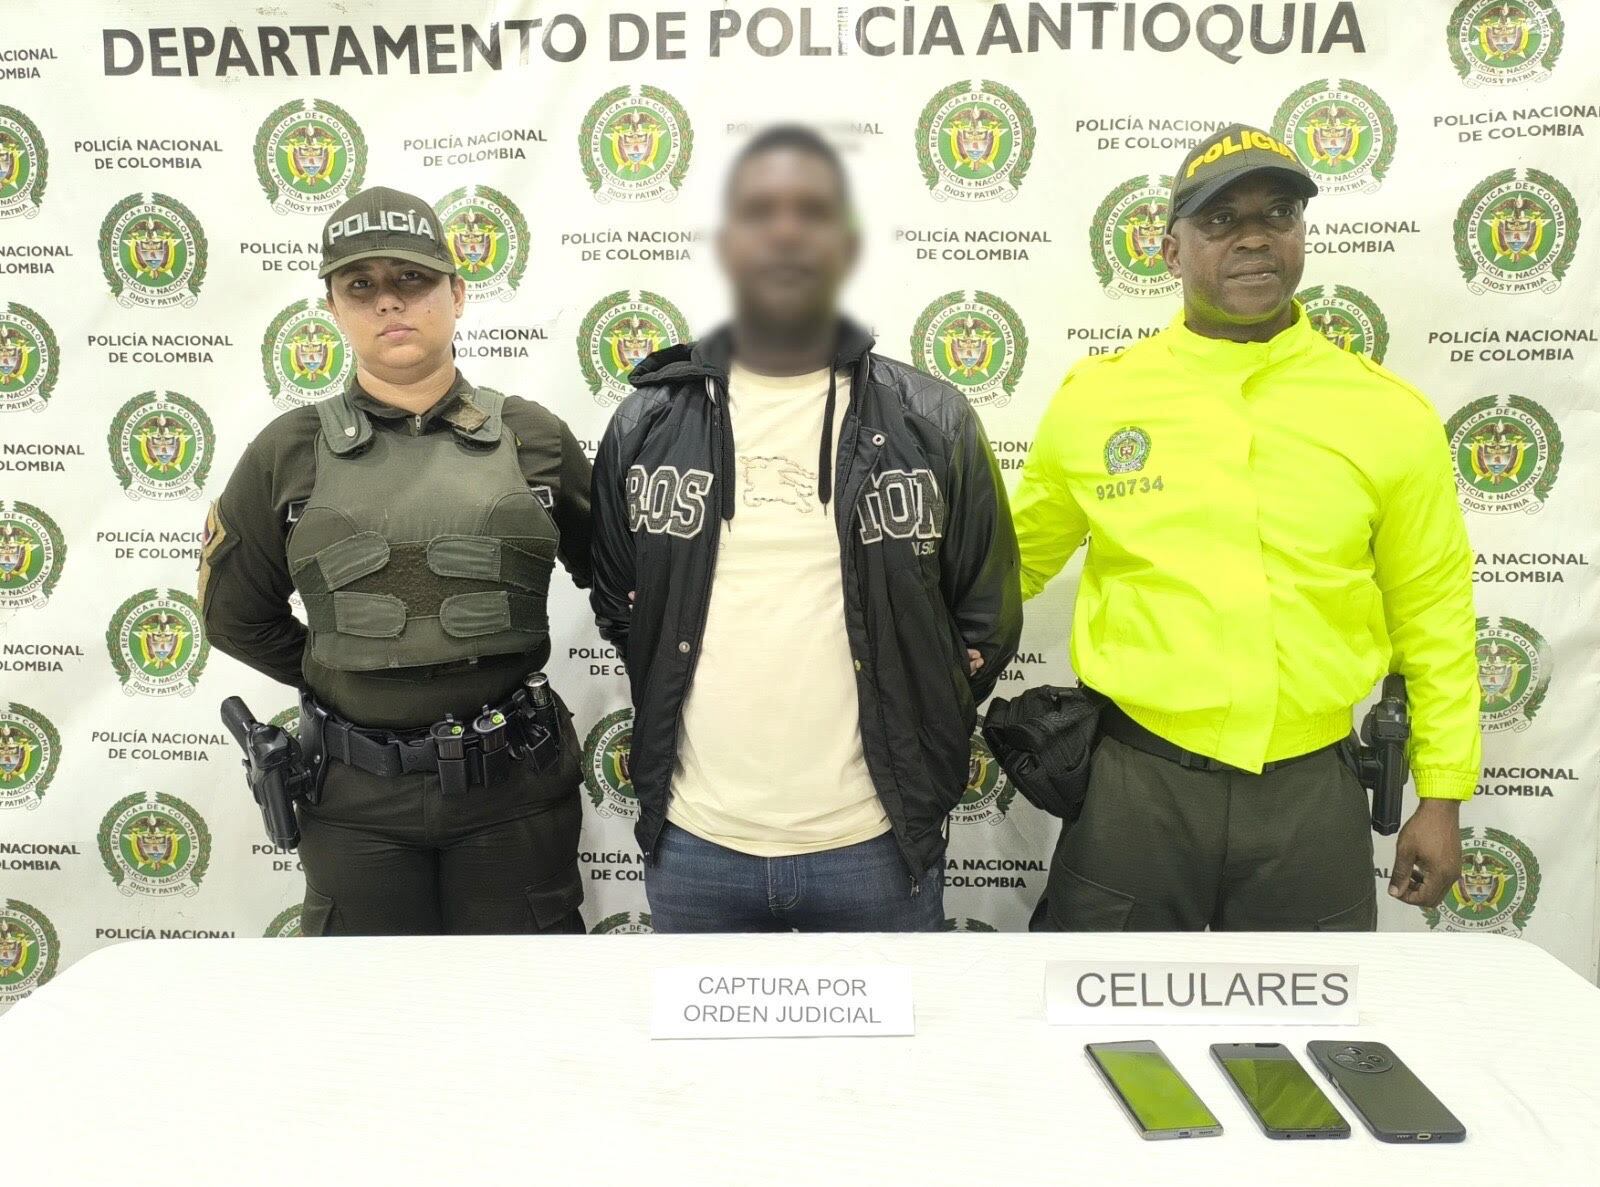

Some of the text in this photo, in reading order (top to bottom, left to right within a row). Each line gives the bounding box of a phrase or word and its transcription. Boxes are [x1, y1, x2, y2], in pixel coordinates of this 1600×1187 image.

[102, 13, 587, 76] DEPARTAMENTO
[608, 11, 687, 62] DE
[976, 1, 1365, 65] ANTIOQUIA
[0, 48, 57, 62] ACIONAL
[0, 67, 40, 80] OMBIA
[993, 98, 1021, 147] COLOMBIA
[1076, 116, 1231, 132] POLICÍA NACIONA
[1434, 105, 1600, 129] POLICÍA NACIONA
[326, 117, 354, 163] COLOMBIA
[1459, 124, 1584, 142] DE COLOMBIA
[75, 137, 222, 152] POLICÍA NACIONAL
[404, 130, 547, 151] POLICÍA NACIONAL
[1098, 137, 1199, 150] DE COLOMB
[424, 145, 526, 166] DE COLOMBIA
[95, 157, 202, 169] DE COLOMBIA
[975, 159, 1016, 186] NACIONAL
[313, 174, 351, 201] NACIONAL
[974, 185, 1004, 199] PATRIA
[313, 199, 342, 213] PATRIA
[1515, 182, 1529, 190] DE
[1537, 188, 1564, 238] COLOMBIA
[144, 205, 156, 213] DE
[165, 210, 195, 257] COLOMBIA
[328, 209, 435, 245] POLICÍA
[1326, 221, 1420, 234] NACIONAL
[562, 229, 622, 245] POLICÍA
[896, 229, 1051, 244] POLICÍA NACIONAL
[241, 240, 303, 254] POLICÍA
[917, 248, 1029, 260] DE COLOMBIA
[582, 249, 690, 261] DE COLOMBIA
[0, 263, 54, 273] LOMBIA
[263, 260, 282, 271] DE
[1515, 249, 1559, 279] NACIONAL
[157, 267, 193, 295] NACIONAL
[1514, 277, 1547, 292] PATRIA
[157, 293, 186, 306] PATRIA
[88, 333, 233, 346] POLICÍA NACIONAL
[468, 329, 548, 340] NACIONAL
[1067, 325, 1133, 340] POLICÍA
[1429, 328, 1598, 343] POLICÍA NACIONAL
[109, 352, 213, 362] DE COLOMBIA
[457, 346, 529, 358] OLOMBIA
[1451, 348, 1574, 362] DE COLOMBIA
[1519, 413, 1547, 461] COLOMBIA
[4, 444, 84, 455] NACIONAL
[0, 461, 65, 471] OLOMBIA
[1096, 475, 1164, 500] 920734
[1496, 472, 1540, 500] NACIONAL
[1495, 497, 1529, 511] PATRIA
[97, 529, 155, 542] POLICÍA
[116, 548, 134, 558] DE
[1493, 553, 1588, 565] NACIONAL
[4, 645, 84, 655] NACIONAL
[569, 648, 620, 659] POLIC
[590, 665, 609, 675] DE
[92, 730, 231, 745] POLICÍA NACIONAL
[109, 748, 208, 761] DE COLOMBIA
[1484, 768, 1579, 780] NACIONAL
[1473, 785, 1553, 797] OLOMBIA
[168, 808, 198, 850] COLOMBIA
[0, 843, 80, 854] NACIONAL
[0, 860, 61, 870] LOMBIA
[158, 859, 196, 884] NACIONAL
[273, 861, 292, 871] DE
[963, 859, 1048, 871] NACIONAL
[592, 869, 611, 880] DE
[159, 882, 188, 894] PATRIA
[96, 927, 156, 939] POLICÍA
[699, 977, 866, 996] CAPTURA POR
[1077, 973, 1348, 1007] CELULARES
[684, 1005, 881, 1023] ORDEN JUDICIAL
